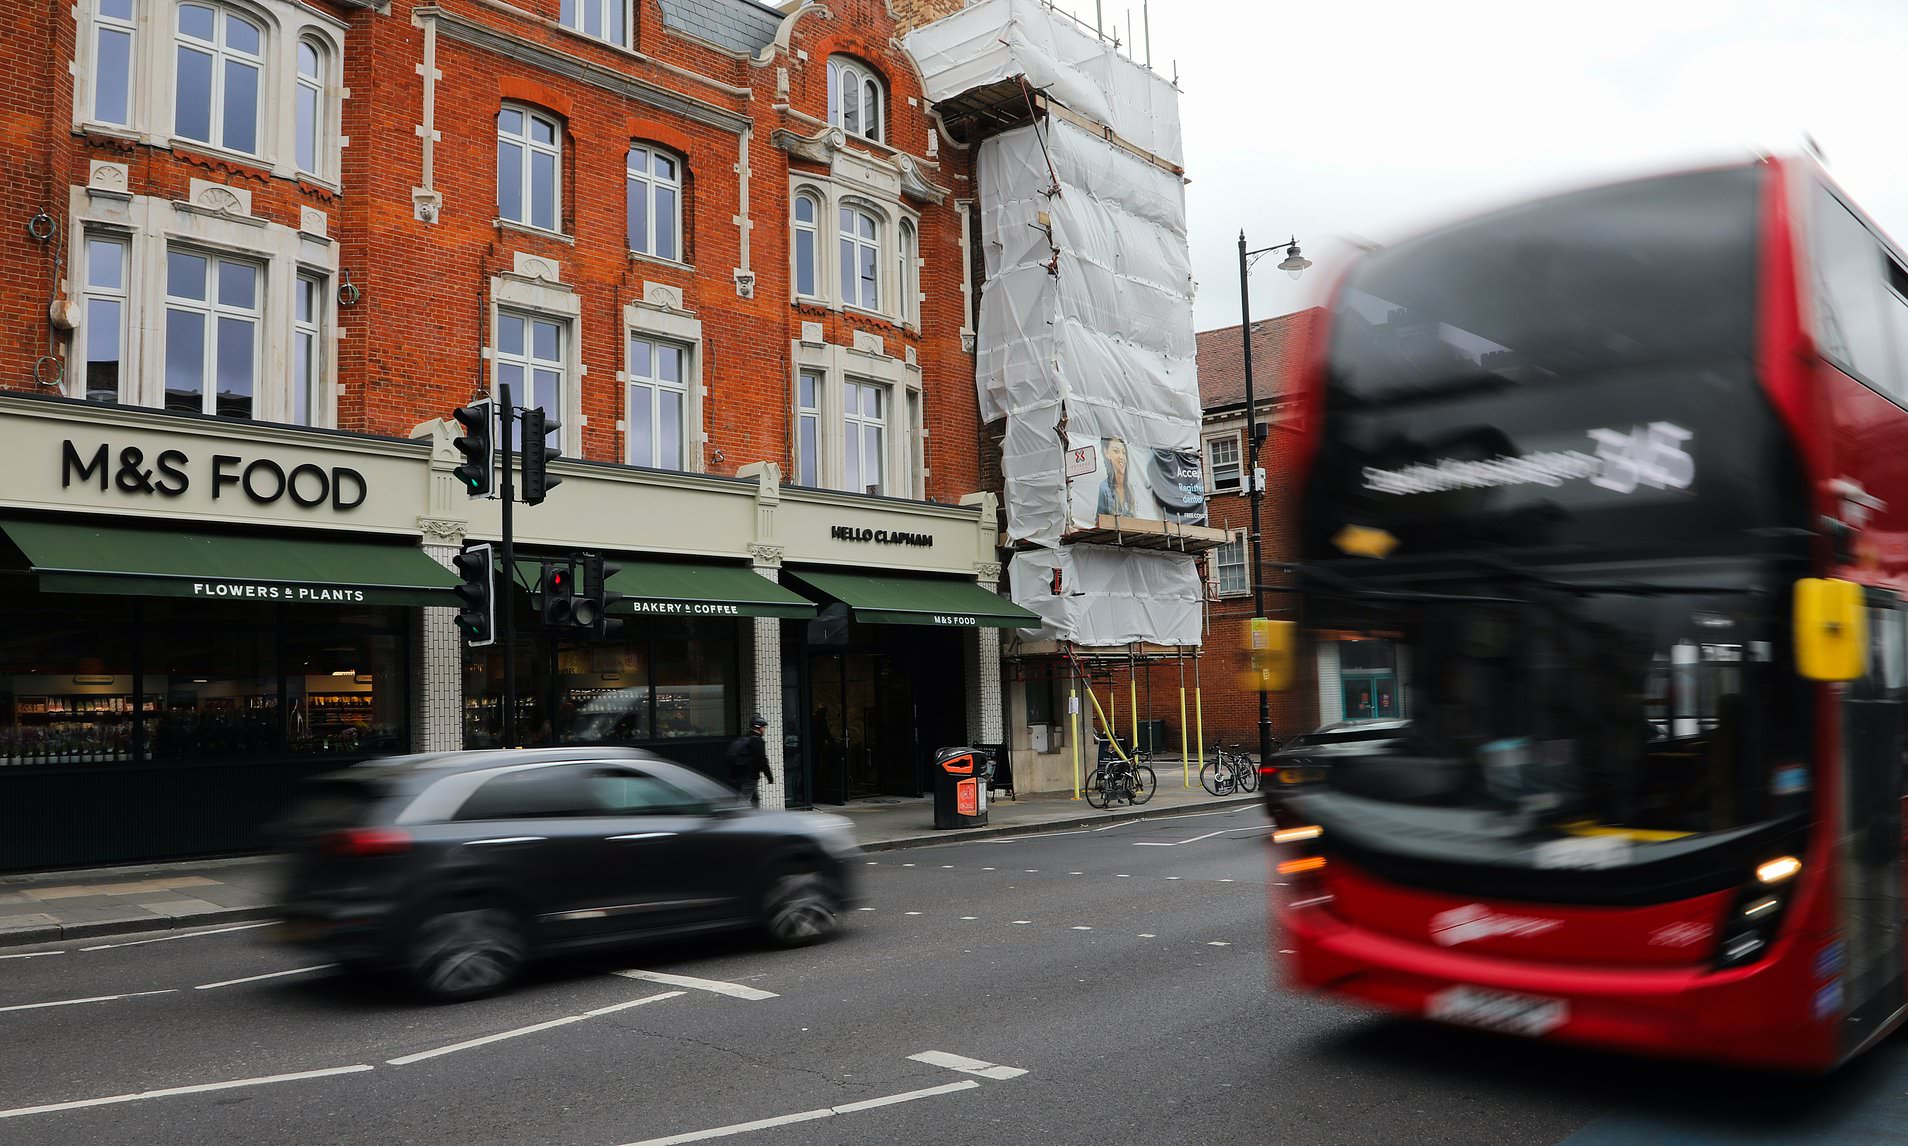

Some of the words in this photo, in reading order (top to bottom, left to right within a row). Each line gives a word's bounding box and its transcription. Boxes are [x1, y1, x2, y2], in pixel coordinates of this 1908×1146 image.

[62, 439, 190, 497] M&S
[211, 454, 367, 511] FOOD
[831, 525, 873, 542] HELLO
[874, 529, 933, 547] CLAPHAM
[193, 583, 279, 598] FLOWERS
[285, 587, 293, 599] &
[299, 588, 364, 601] PLANTS
[633, 602, 681, 613] BAKERY
[685, 604, 691, 613] &
[694, 604, 738, 614] COFFEE
[934, 615, 952, 624] M&S
[953, 616, 975, 625] FOOD
